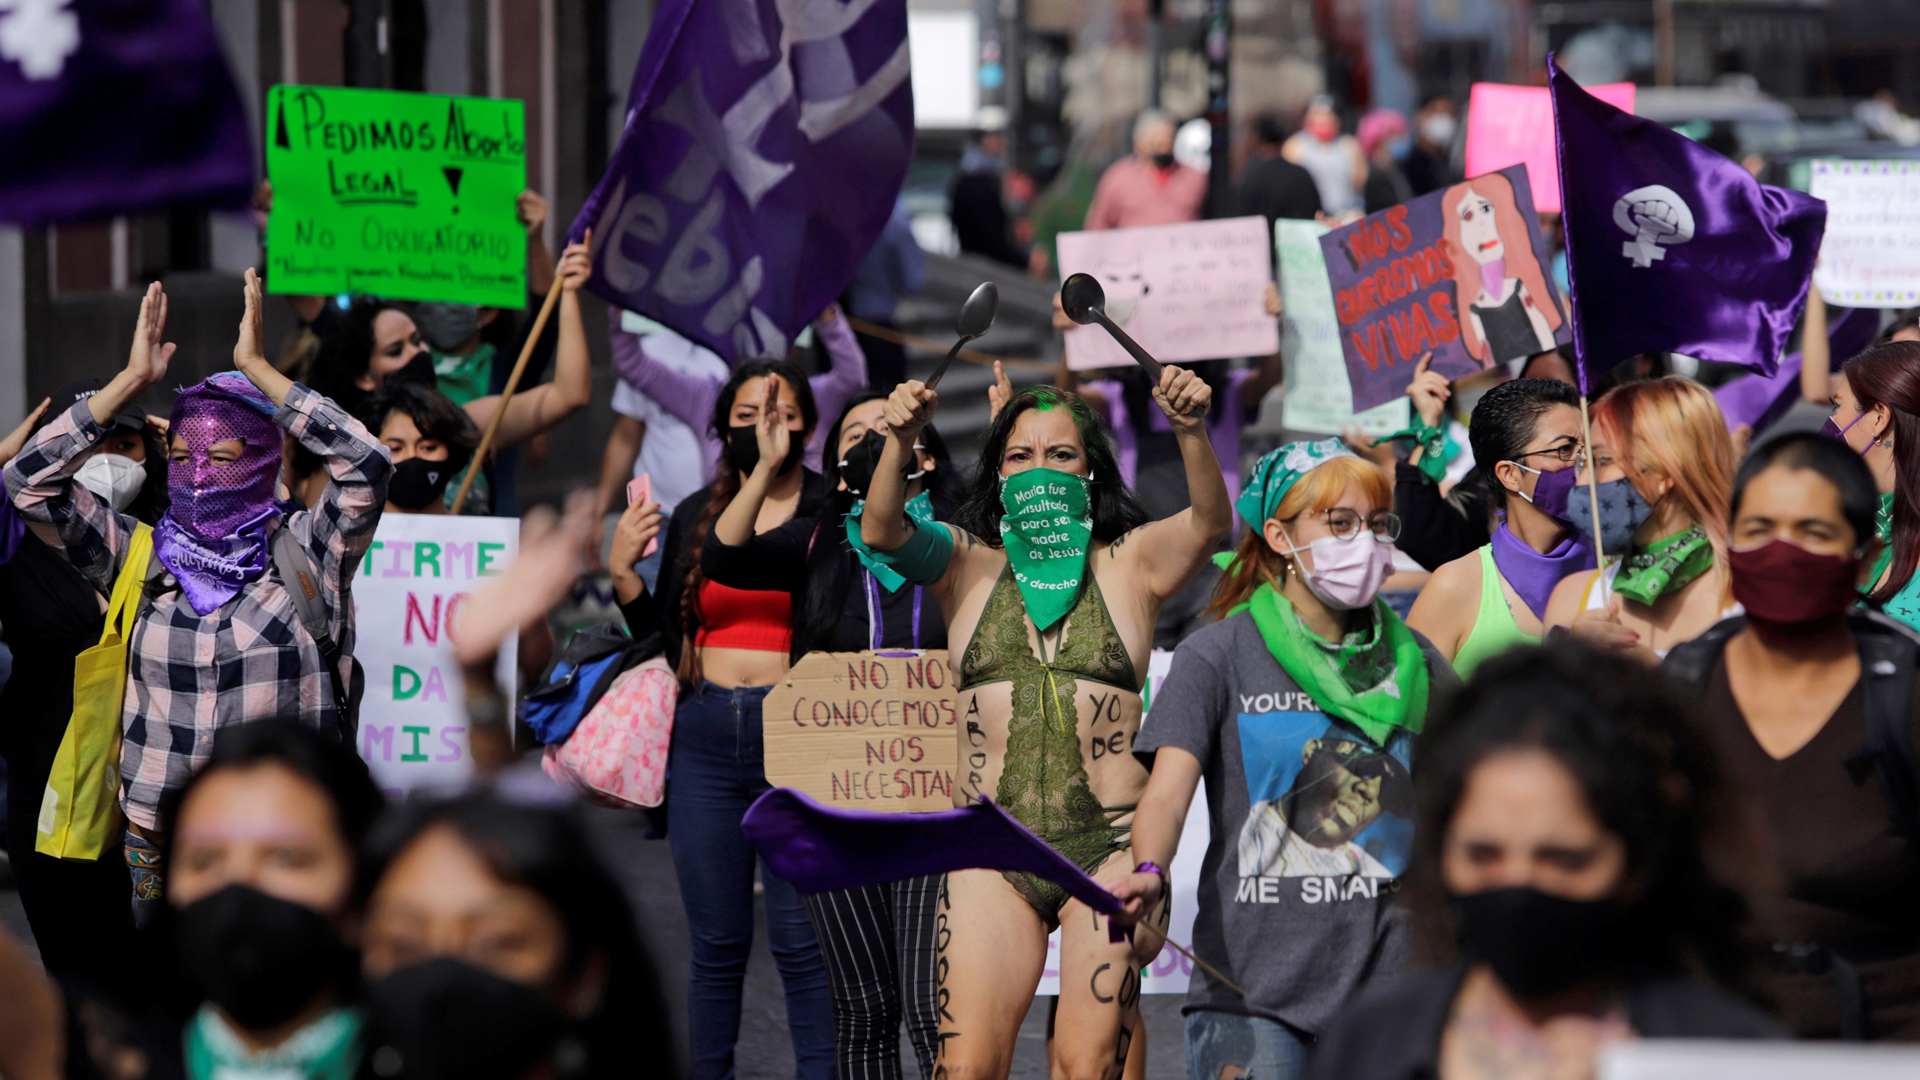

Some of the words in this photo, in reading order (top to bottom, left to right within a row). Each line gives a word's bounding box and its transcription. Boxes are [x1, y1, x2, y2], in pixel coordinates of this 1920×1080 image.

[328, 157, 418, 196] LEGAL
[1336, 237, 1458, 325] QUEREMOS
[1352, 291, 1460, 371] VIVAS
[1048, 483, 1067, 495] fue
[1021, 519, 1050, 531] para
[1031, 531, 1070, 545] madre
[1029, 549, 1044, 560] de
[1048, 547, 1084, 559] Jesús.
[1030, 579, 1078, 590] derecho
[906, 658, 956, 689] NO
[794, 697, 956, 727] CONOCEMOS
[1089, 692, 1122, 727] YO
[1239, 691, 1320, 713] YOU'R
[866, 736, 924, 766] NOS
[1234, 876, 1280, 903] ME
